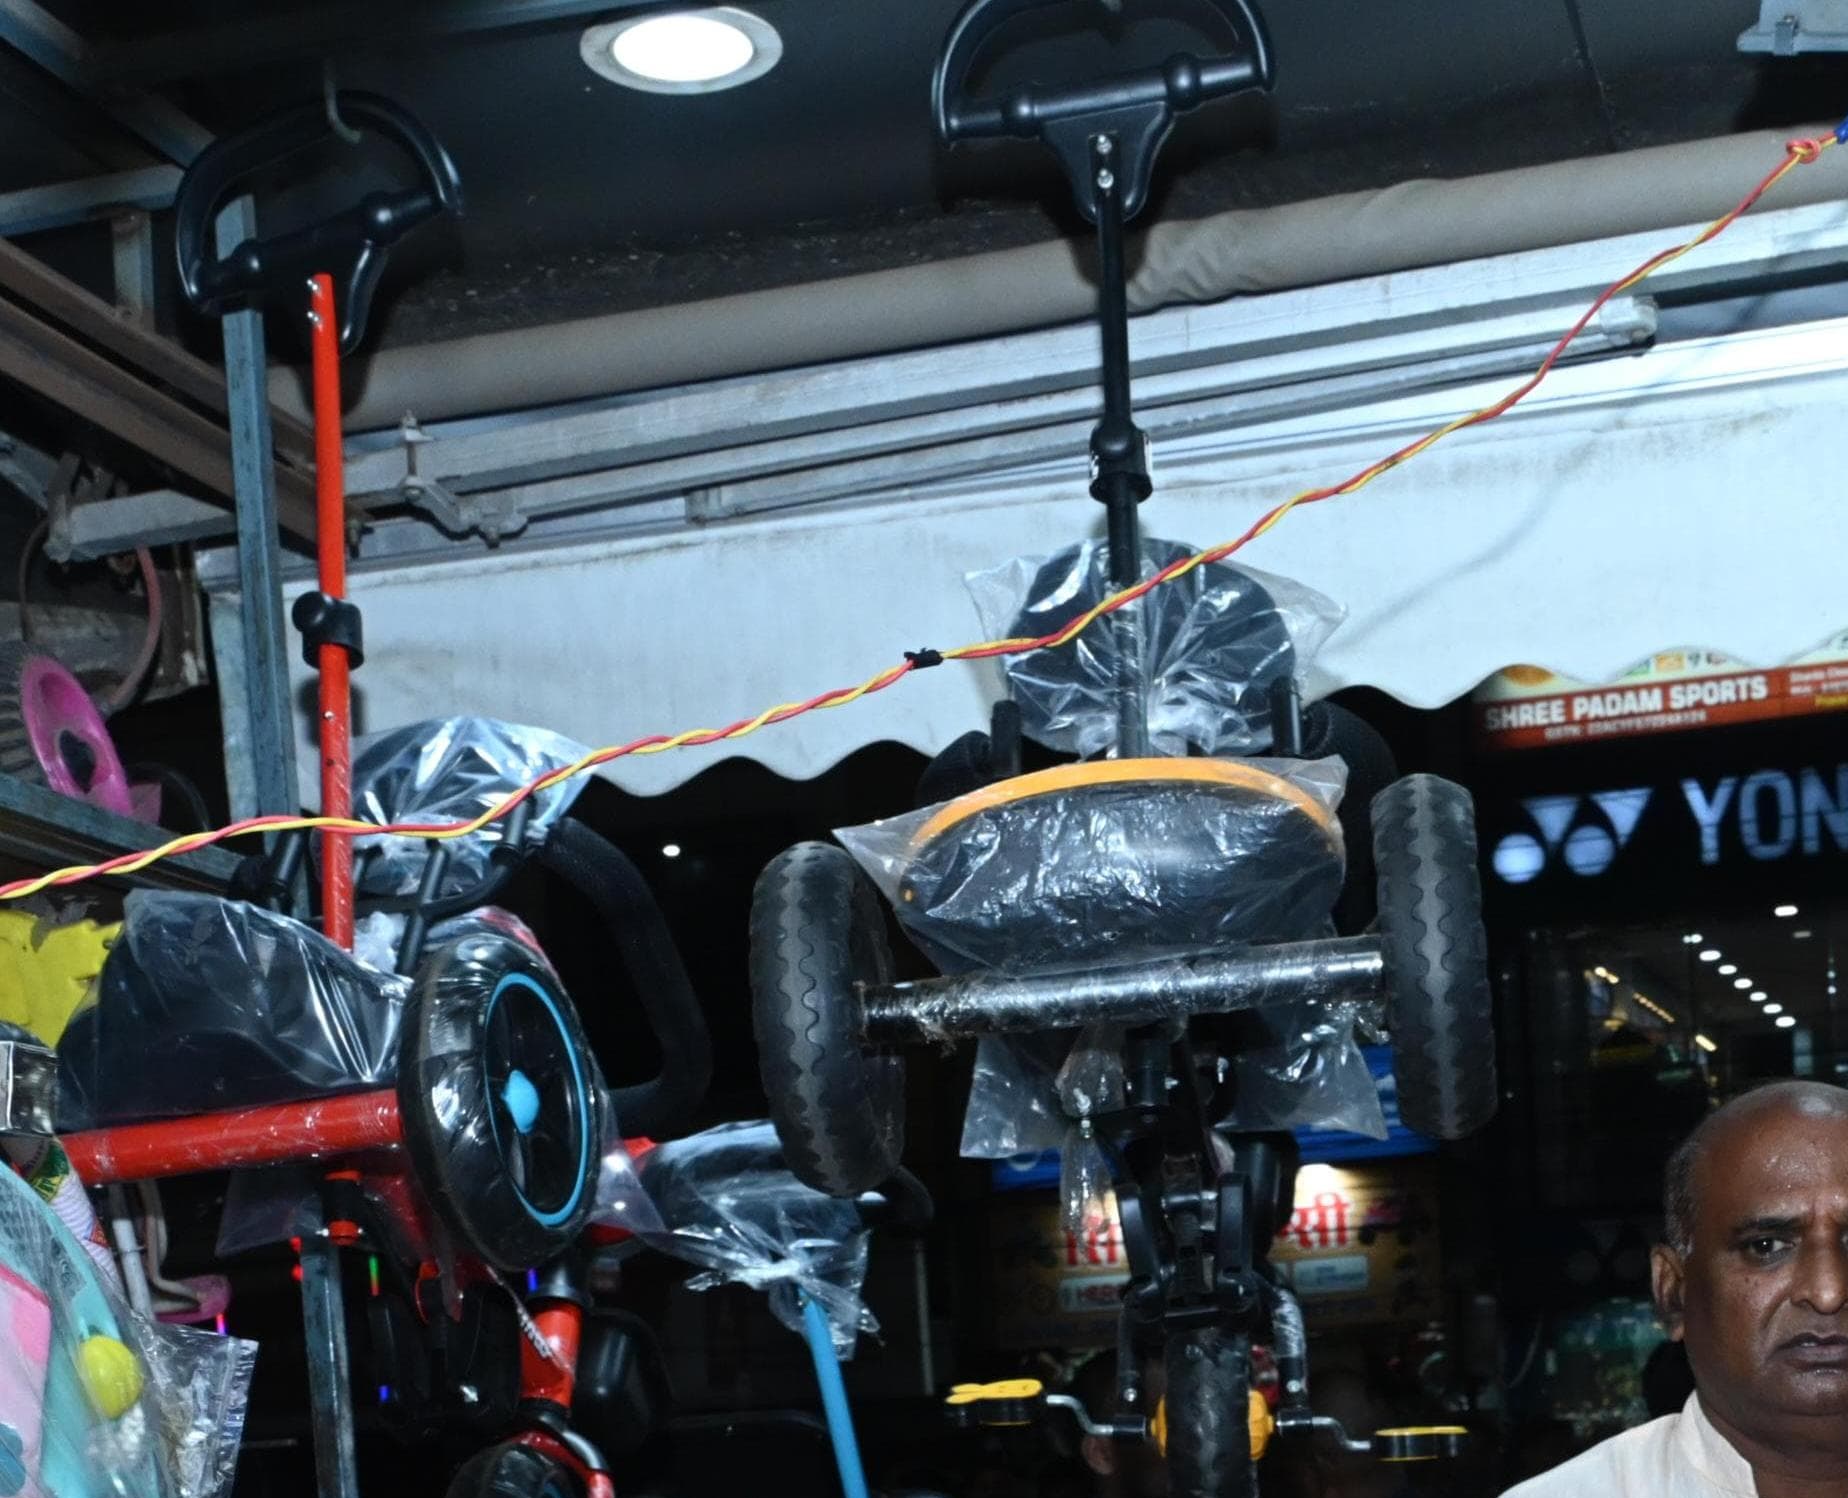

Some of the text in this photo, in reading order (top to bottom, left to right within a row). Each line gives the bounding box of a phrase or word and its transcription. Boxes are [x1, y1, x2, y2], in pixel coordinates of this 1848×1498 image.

[1486, 698, 1566, 731] SHREE
[1573, 687, 1663, 720] PADAM
[1670, 675, 1768, 711] SPORTS
